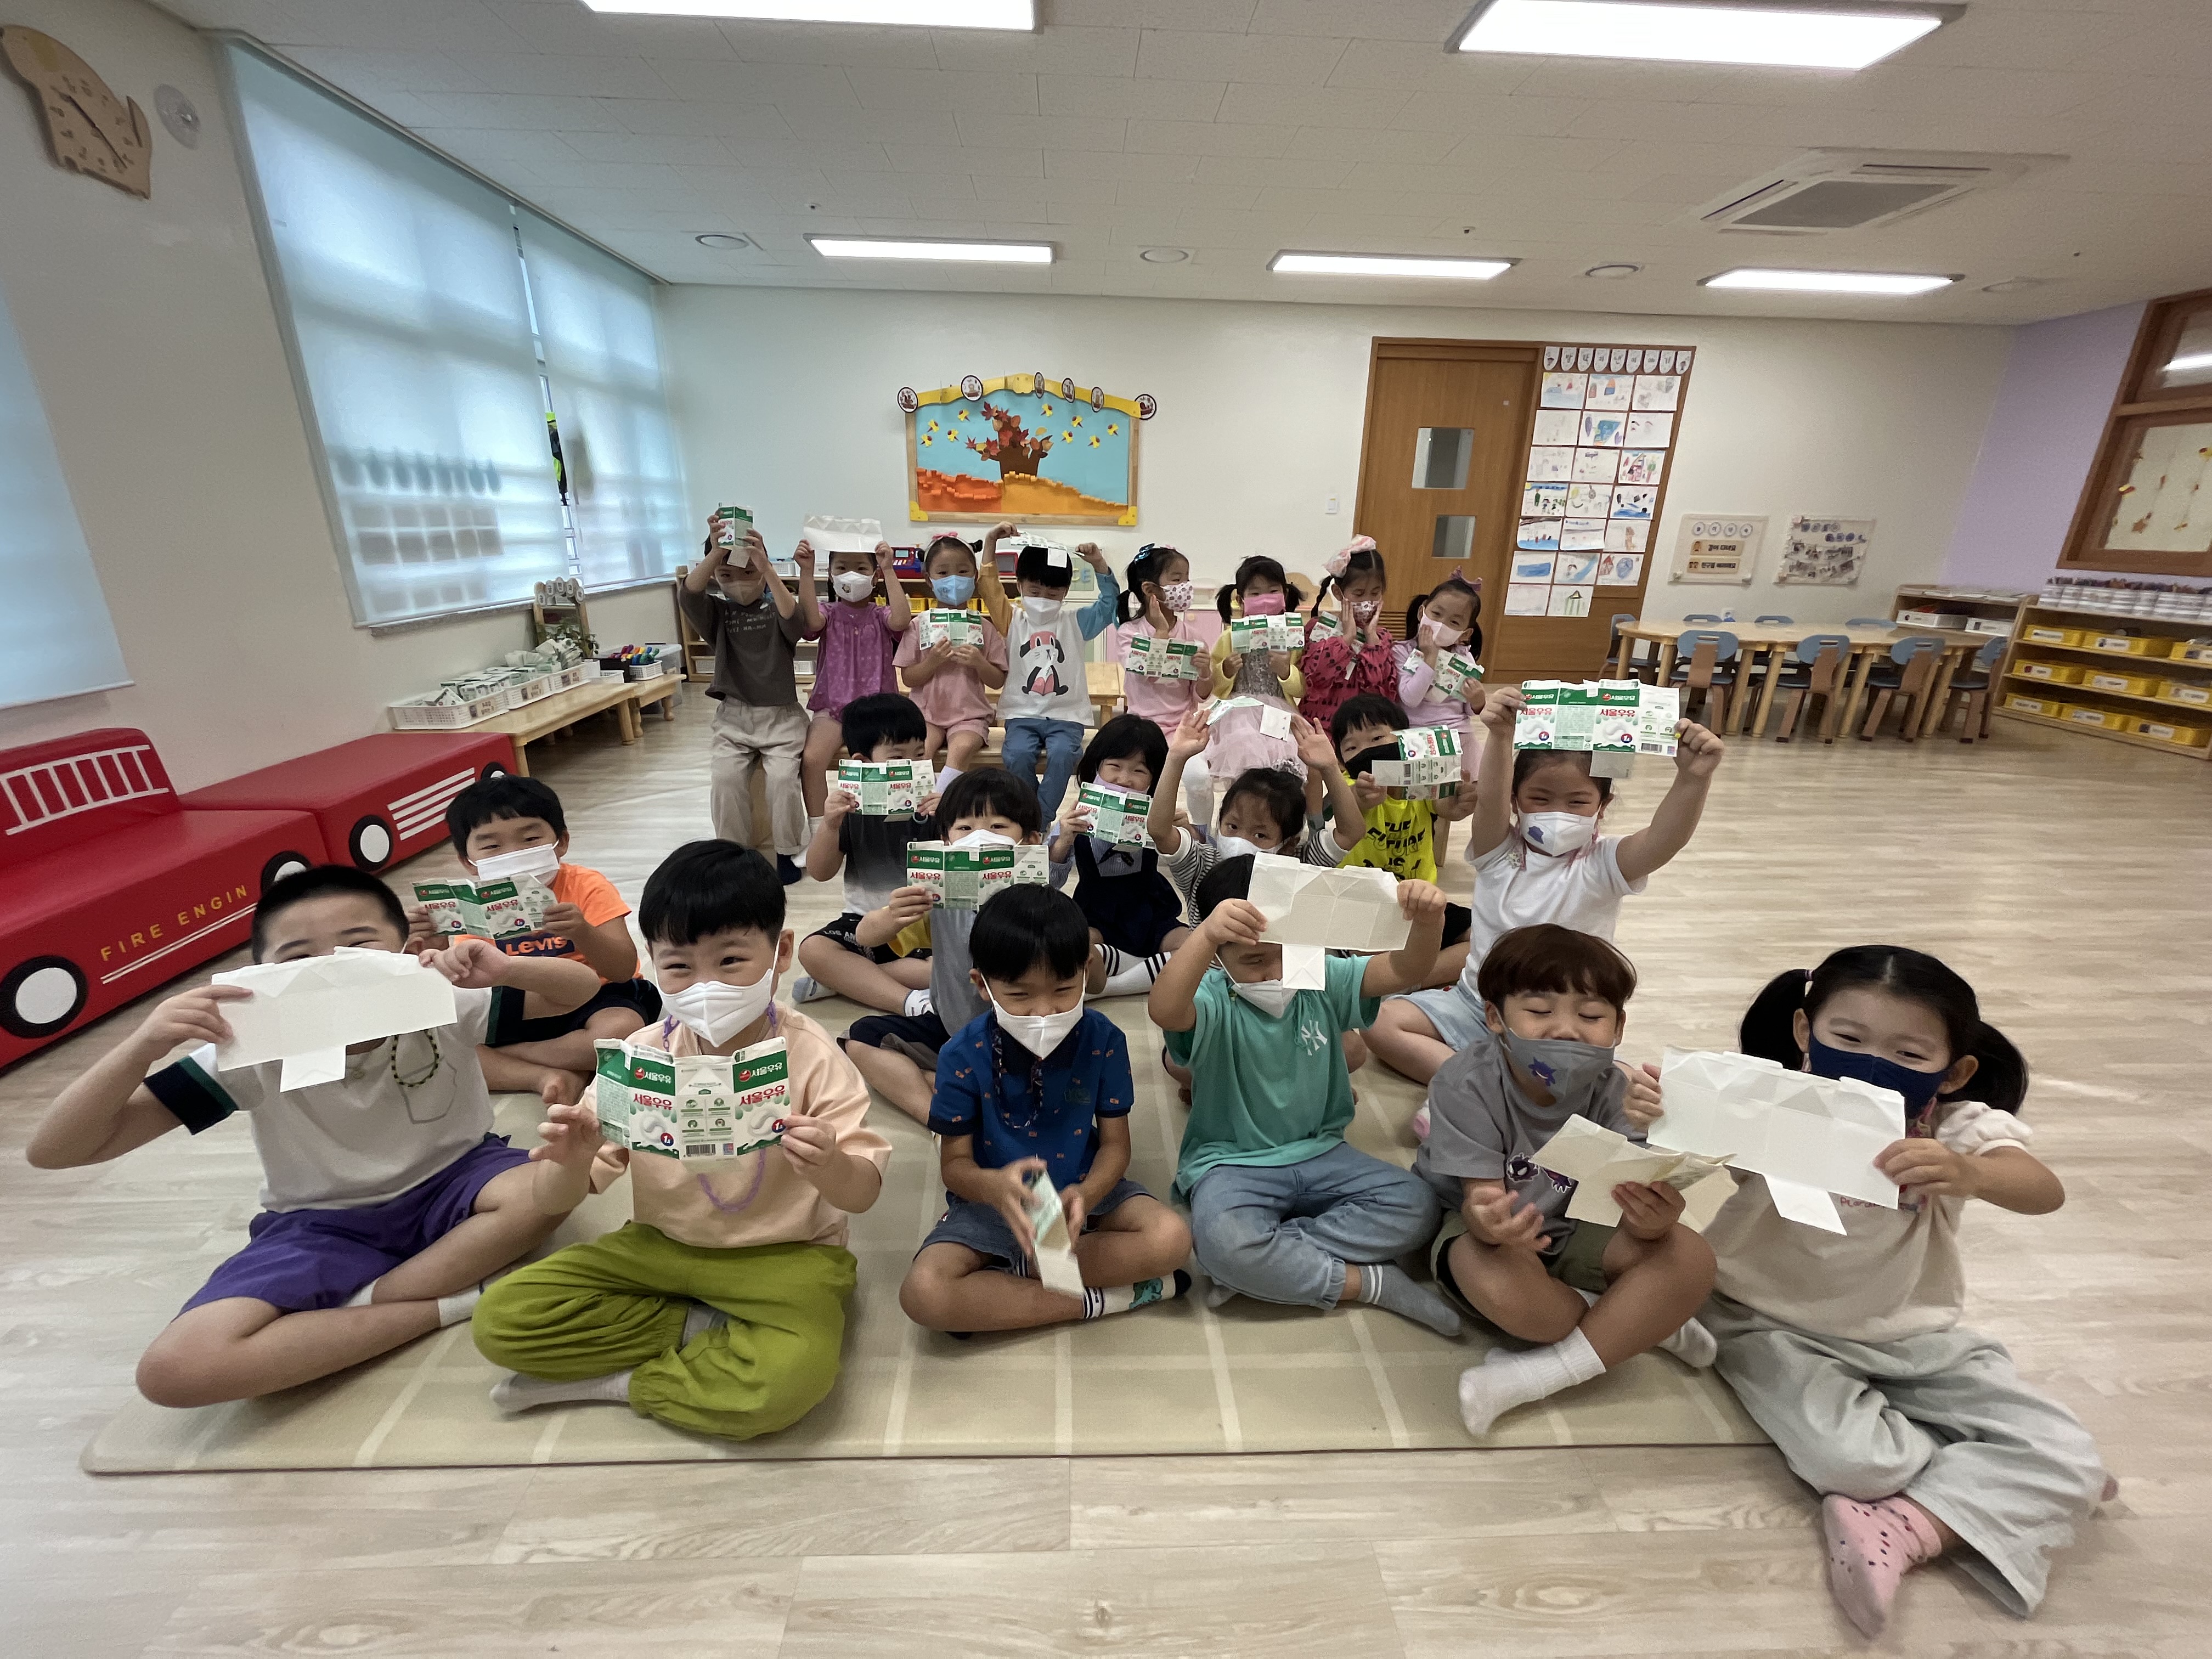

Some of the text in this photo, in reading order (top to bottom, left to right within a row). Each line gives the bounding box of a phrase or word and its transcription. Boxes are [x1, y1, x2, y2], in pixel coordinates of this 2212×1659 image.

[1520, 707, 1553, 716] 서울우유
[1599, 708, 1636, 718] 서울우유
[910, 871, 941, 880] 서울우유
[982, 871, 1012, 881] 서울우유
[100, 884, 247, 961] FIRE ENGIN
[1301, 1019, 1328, 1056] NY
[751, 1062, 783, 1077] 서울우유
[644, 1071, 672, 1085] 서울우유
[633, 1093, 673, 1111] 서울우유
[739, 1085, 786, 1107] 서울우유
